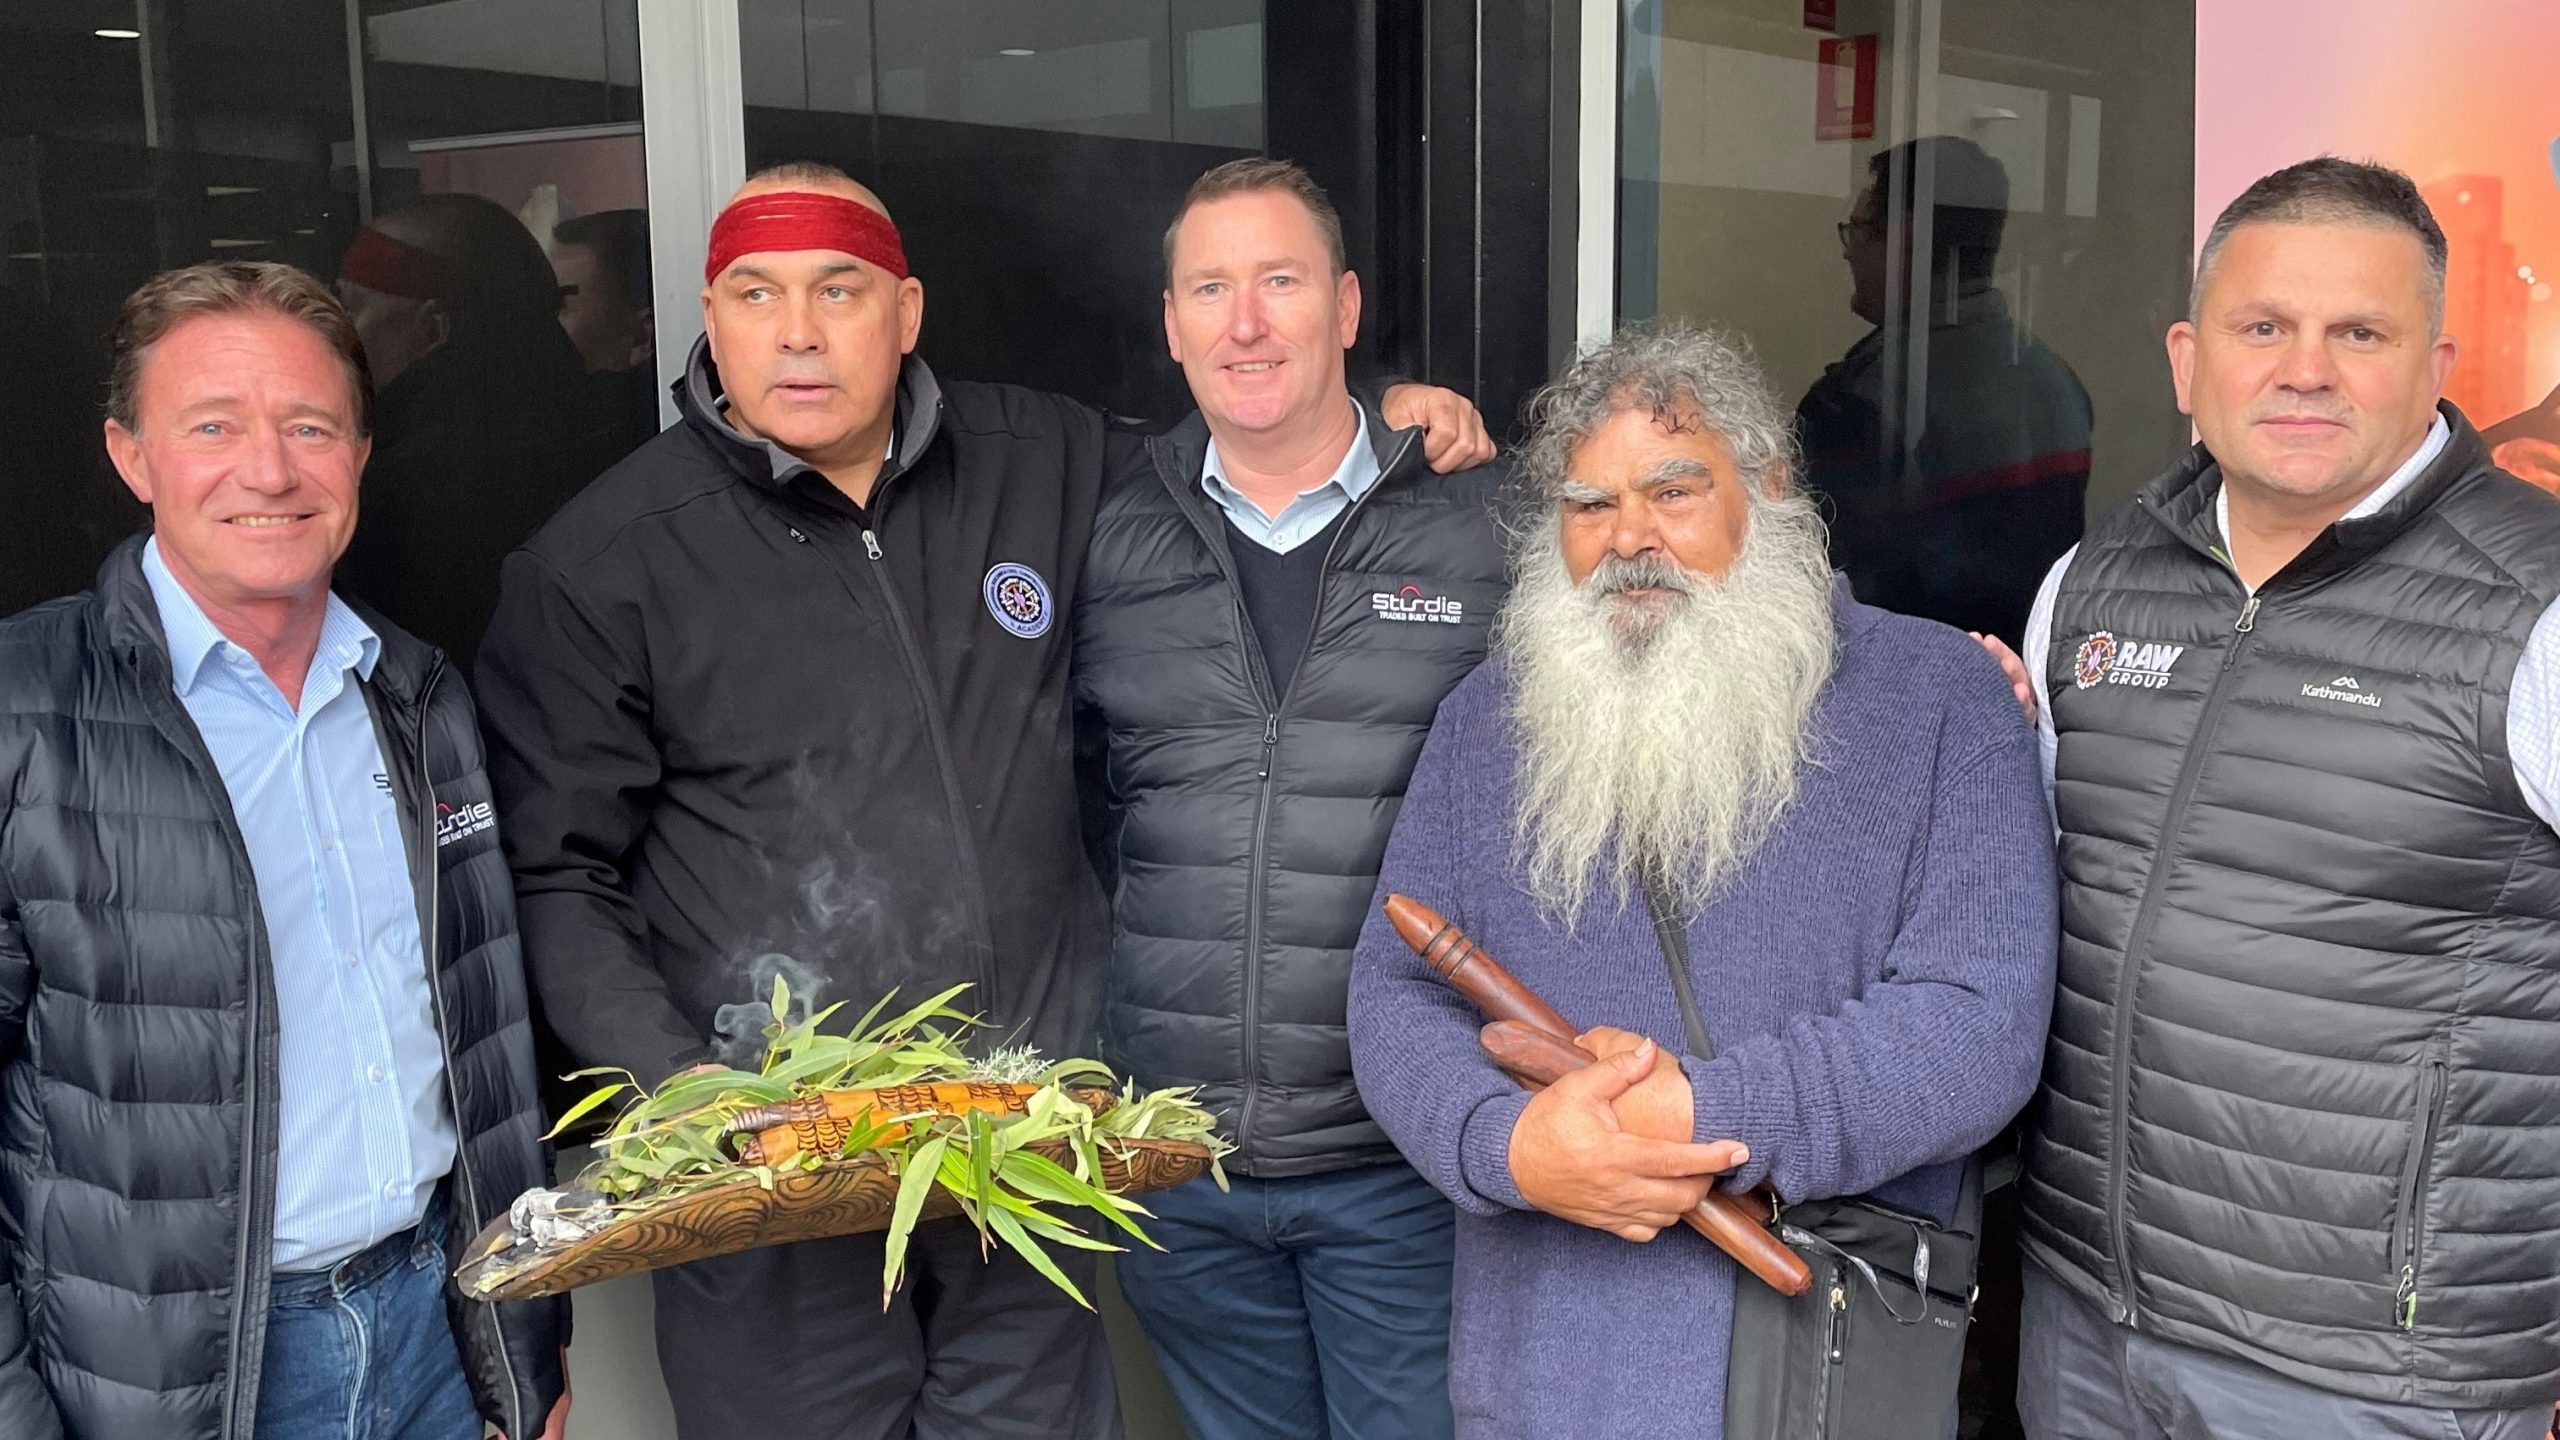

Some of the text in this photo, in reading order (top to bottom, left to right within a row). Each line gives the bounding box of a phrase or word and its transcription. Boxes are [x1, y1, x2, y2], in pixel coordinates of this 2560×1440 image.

[1372, 592, 1462, 615] Sturdie
[1379, 611, 1461, 624] TRADES BUILT ON TRUST
[2115, 641, 2184, 672] RAW
[2108, 671, 2169, 689] GROUP
[2301, 683, 2381, 707] Kathmandu
[437, 802, 492, 835] urdie
[472, 816, 494, 831] TRUST
